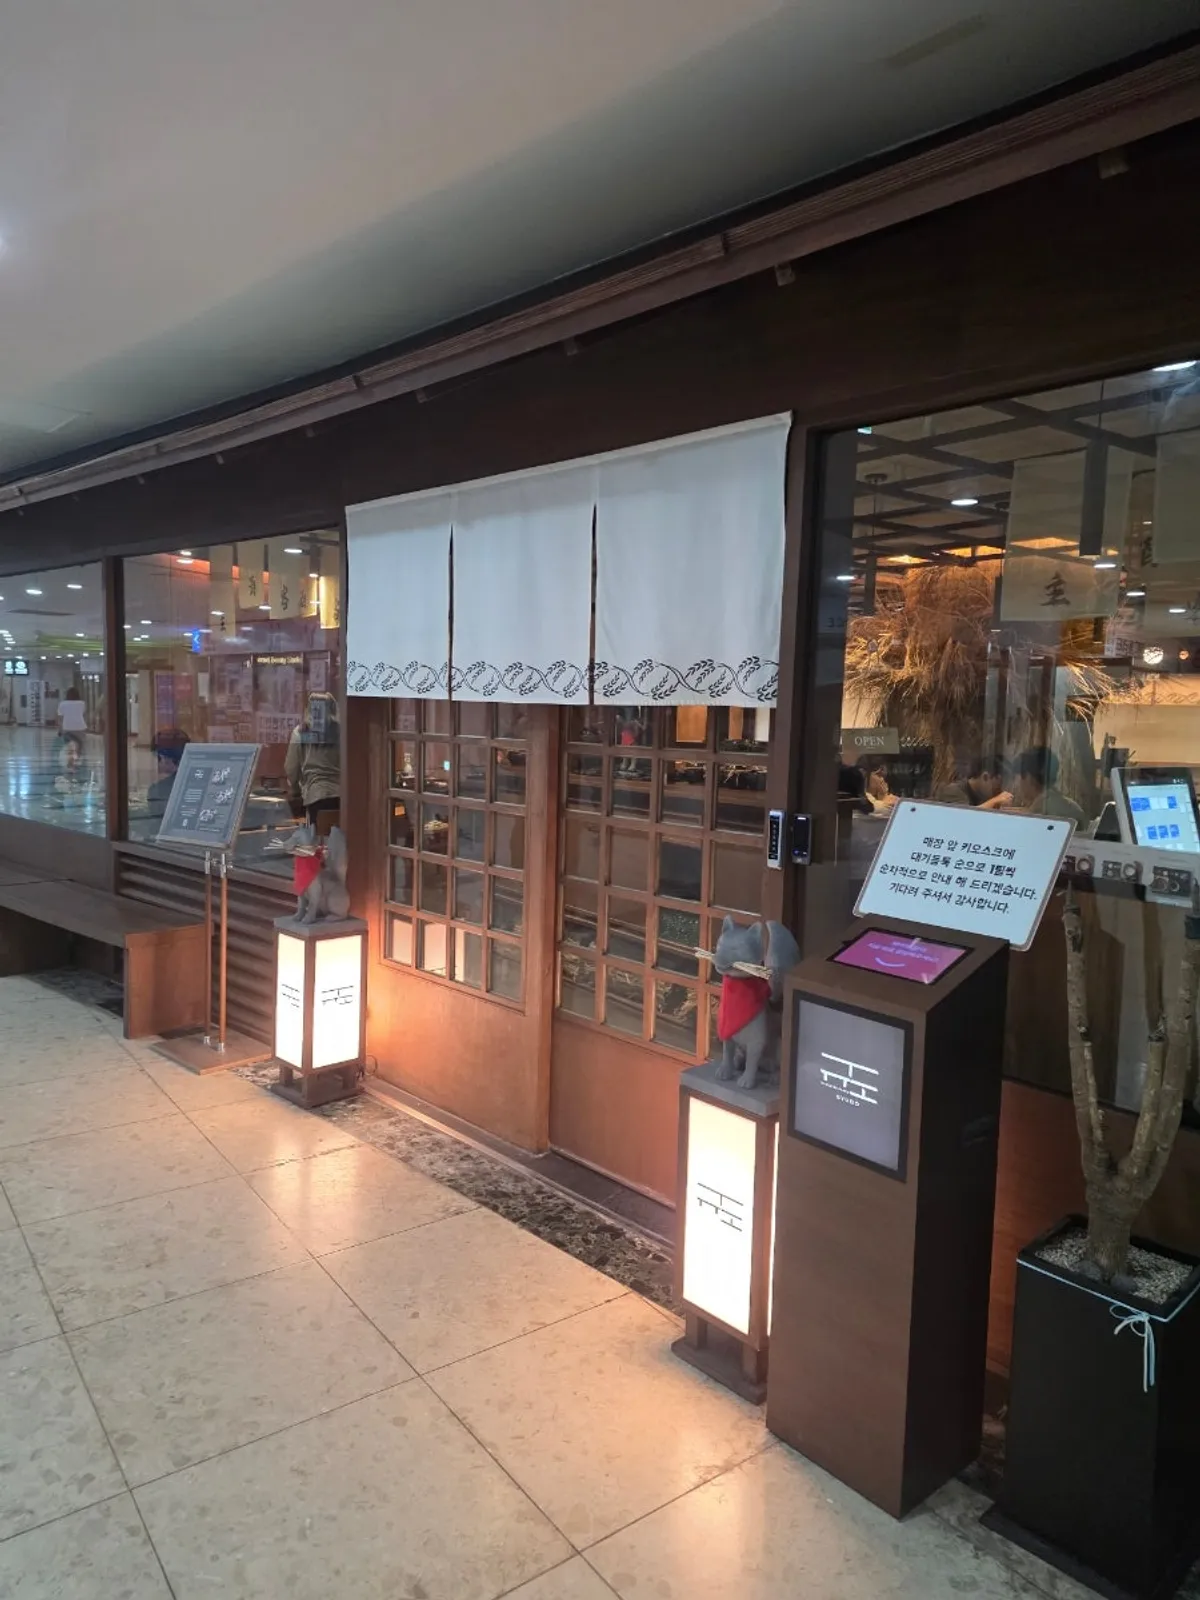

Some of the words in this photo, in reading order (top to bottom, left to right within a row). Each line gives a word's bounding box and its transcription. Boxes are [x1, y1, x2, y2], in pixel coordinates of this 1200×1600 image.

[854, 736, 885, 746] OPEN
[923, 837, 944, 849] 매장
[947, 840, 958, 851] 앞
[961, 843, 1016, 860] 키오스크에
[911, 851, 951, 867] 대기등록
[954, 859, 986, 872] 순으로
[989, 864, 1016, 878] 1팀씩
[879, 864, 928, 880] 순차적으로
[931, 872, 953, 885] 안내
[955, 876, 968, 888] 해
[969, 879, 1037, 900] 드리겠습니다.
[889, 882, 919, 897] 기다려
[922, 888, 953, 903] 주셔서
[955, 895, 1009, 914] 감사합니다.
